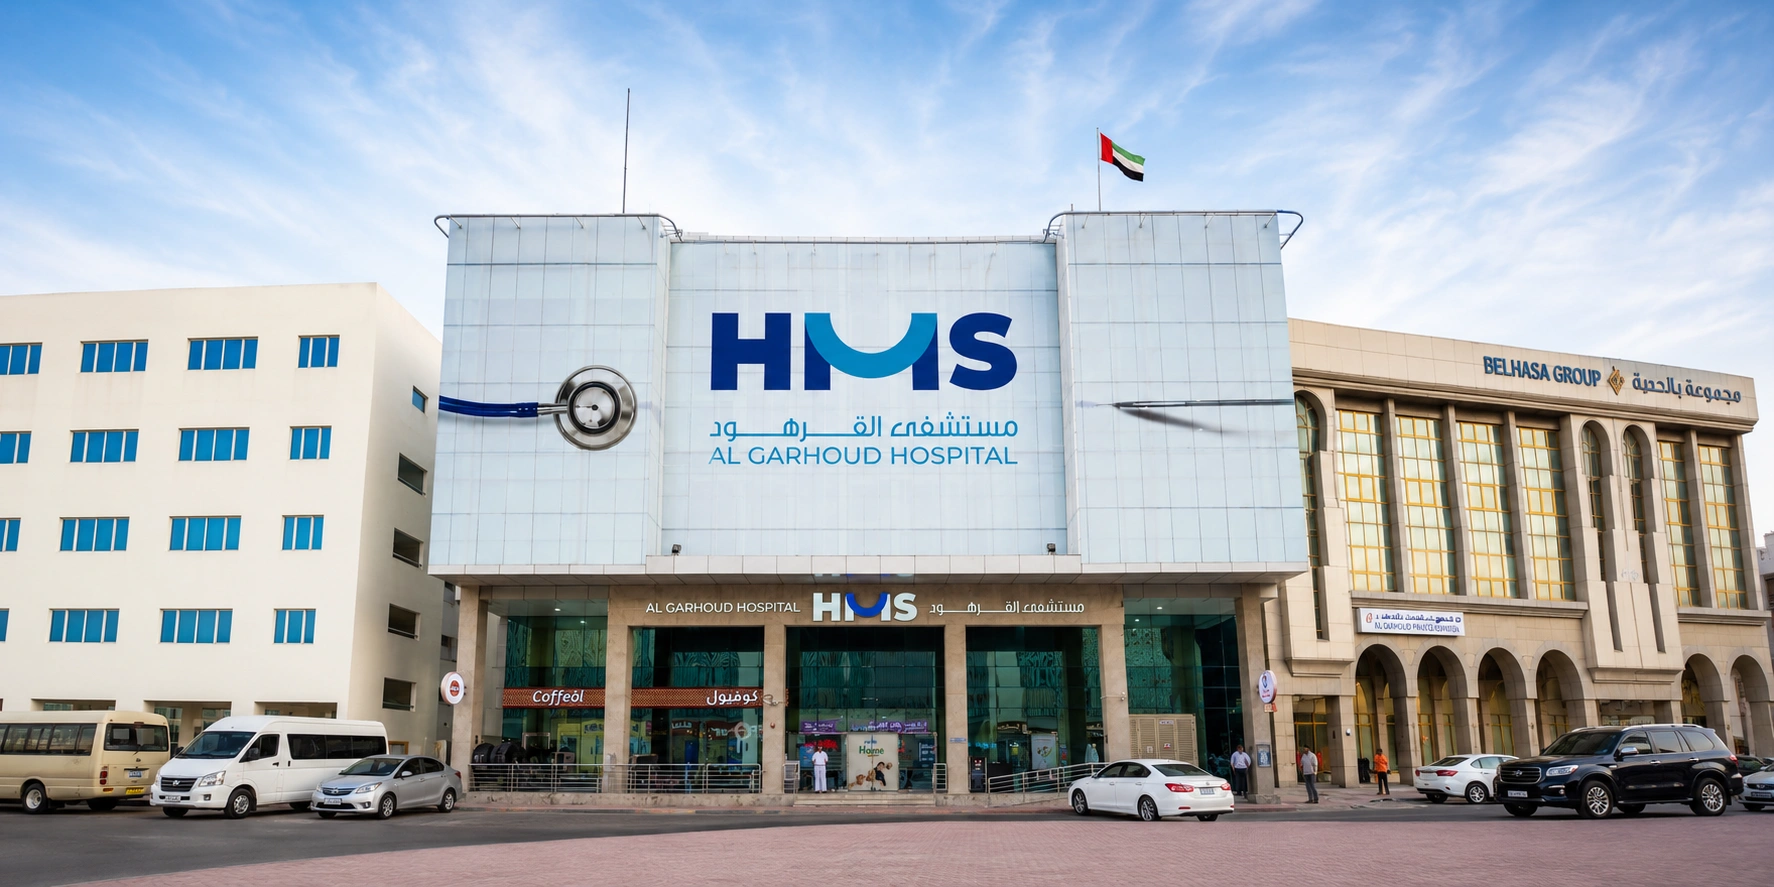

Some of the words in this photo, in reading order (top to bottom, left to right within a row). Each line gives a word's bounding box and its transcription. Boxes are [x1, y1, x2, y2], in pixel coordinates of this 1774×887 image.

[710, 312, 1018, 390] HMS
[1483, 355, 1551, 382] BELHASA
[1552, 365, 1602, 387] GROUP
[1685, 379, 1742, 405] مجموعة
[890, 411, 1018, 437] مستشفى
[708, 446, 741, 465] AL
[748, 446, 882, 465] GARHOUD
[891, 446, 1018, 465] HOSPITAL
[645, 602, 662, 613] AL
[665, 602, 733, 613] GARHOUD
[736, 602, 801, 613] HOSPITAL
[812, 592, 918, 622] HMS
[706, 690, 758, 706] كوفيول
